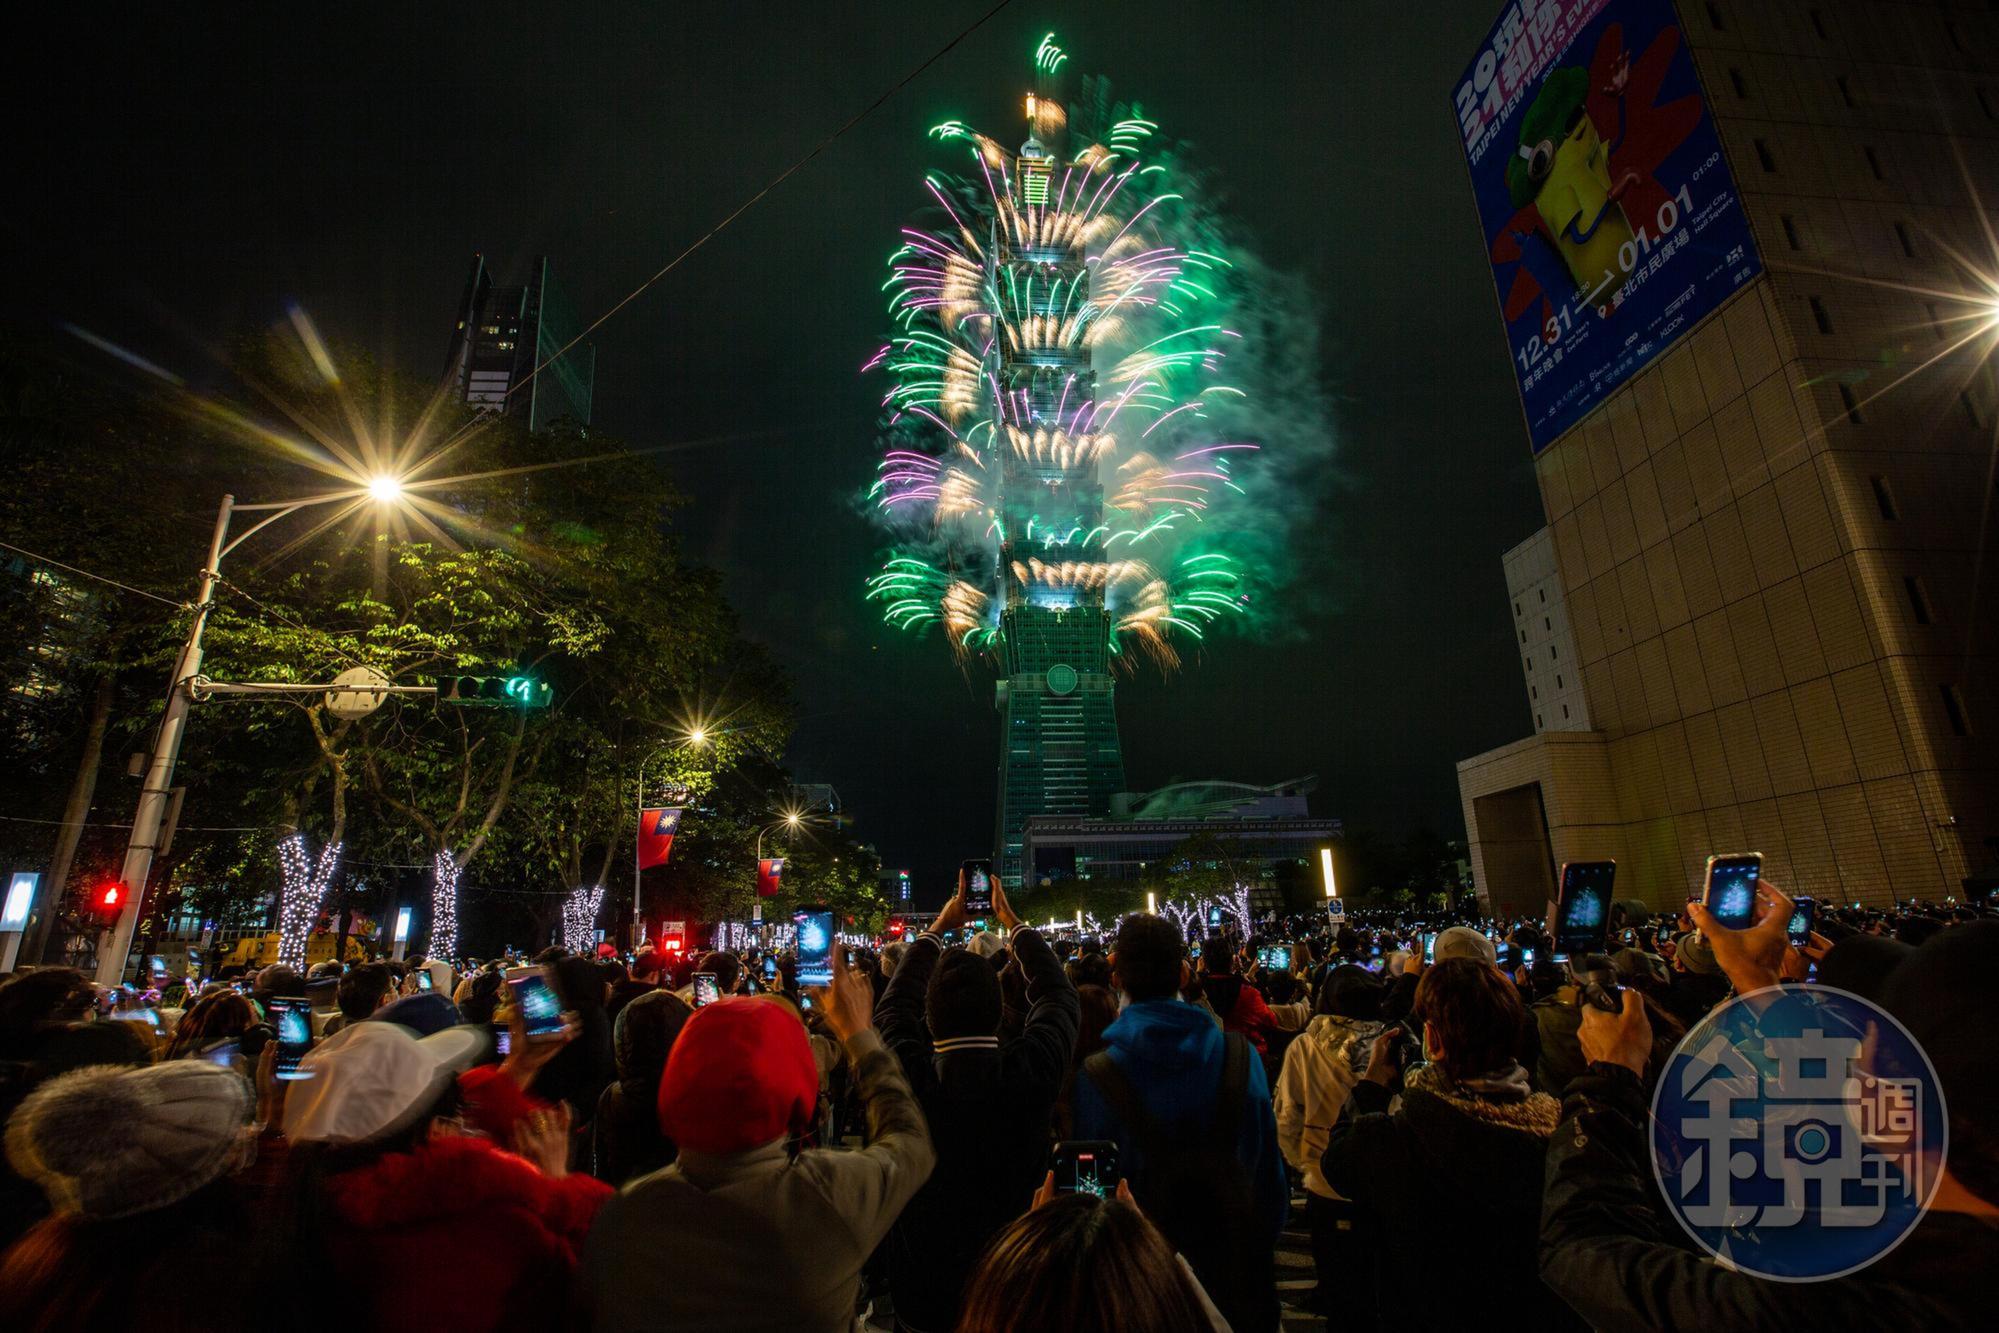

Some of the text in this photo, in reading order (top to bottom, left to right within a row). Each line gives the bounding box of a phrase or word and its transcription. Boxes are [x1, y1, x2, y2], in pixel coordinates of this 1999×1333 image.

[1470, 120, 1502, 166] TAIPEI
[1501, 85, 1525, 125] NEW
[1523, 24, 1566, 88] YEAR'S
[1707, 196, 1734, 222] Square
[1711, 191, 1728, 209] City
[1518, 304, 1574, 372] 12.31
[1618, 184, 1695, 273] 01.01
[1692, 151, 1720, 181] 01:00
